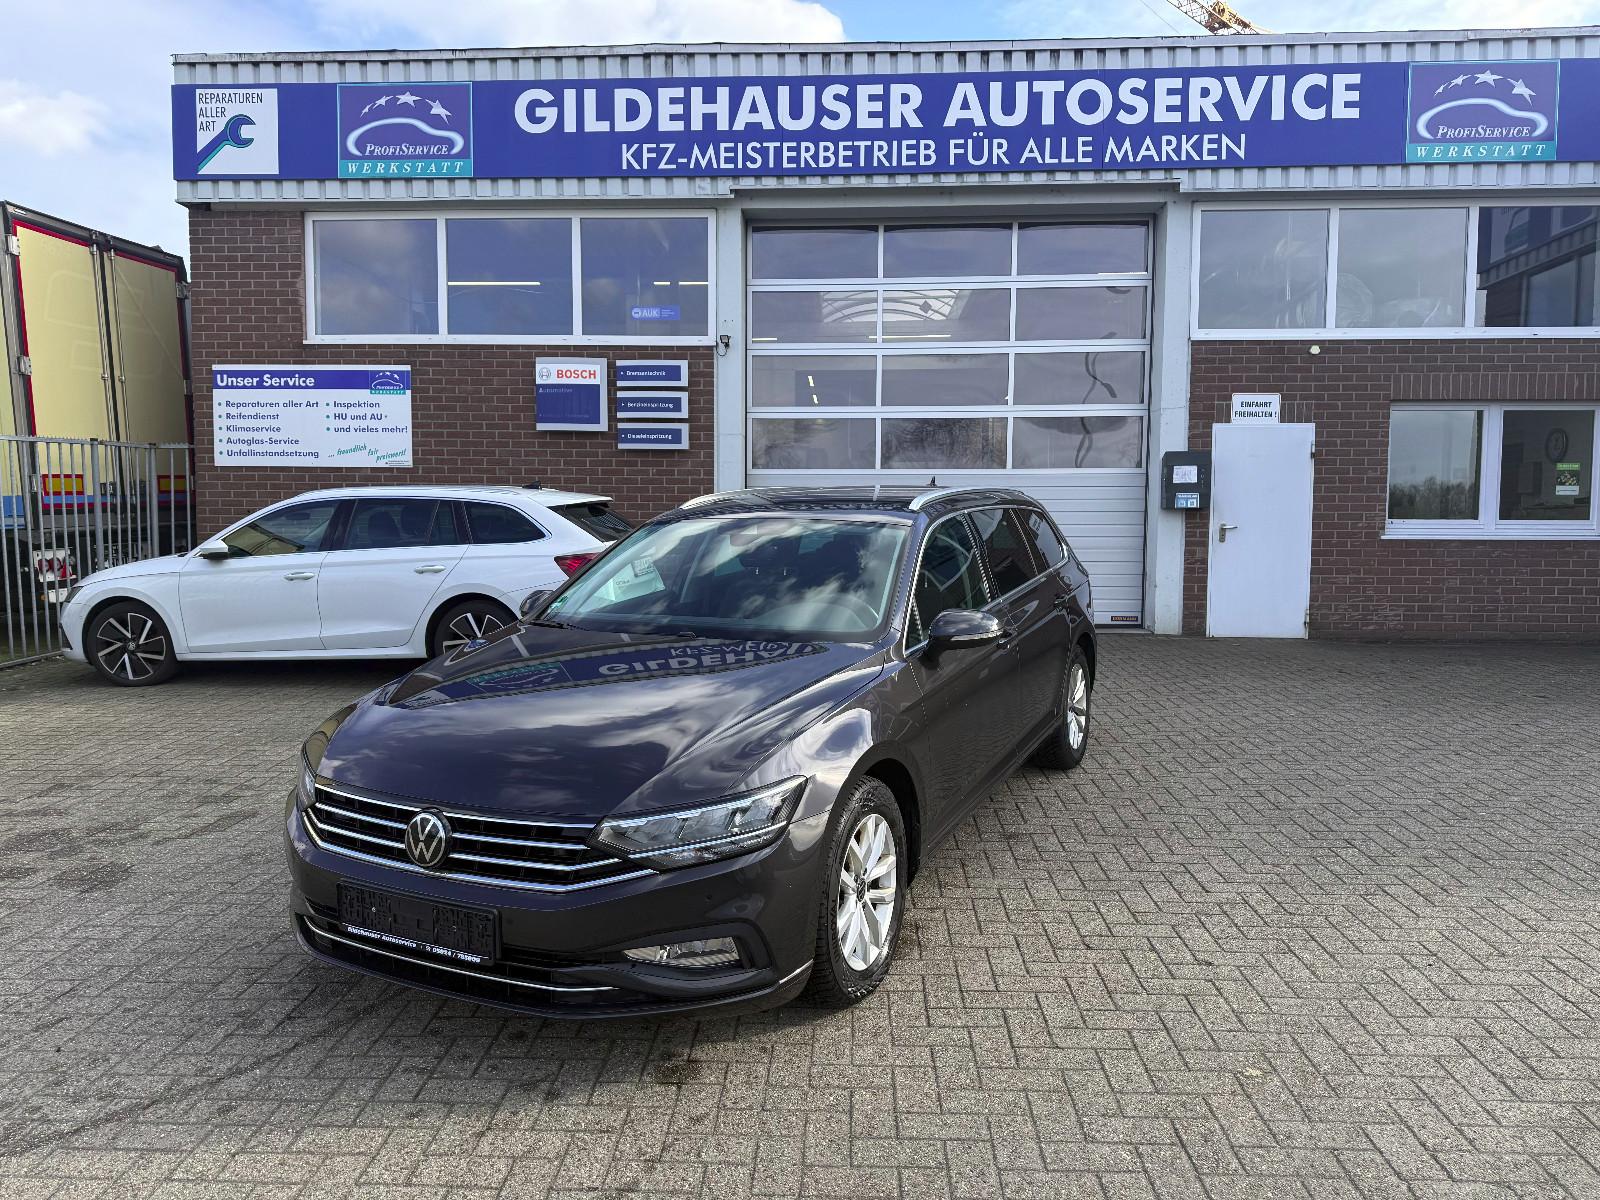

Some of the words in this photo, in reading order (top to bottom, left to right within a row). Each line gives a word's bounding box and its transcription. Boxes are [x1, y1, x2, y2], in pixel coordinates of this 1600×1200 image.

[198, 92, 263, 104] REPARATUREN
[514, 83, 924, 134] GILDEHAUSER
[943, 72, 1362, 127] AUTOSERVICE
[198, 107, 227, 118] ALLER
[198, 121, 217, 132] ART
[622, 139, 937, 170] KFZ-MEISTERBETRIEB
[948, 131, 1010, 167] FÜR
[1020, 134, 1094, 165] ALLE
[1103, 133, 1247, 164] MARKEN
[1416, 144, 1546, 158] WERKSTATT
[347, 161, 463, 174] WERKSTATT
[216, 374, 260, 387] Unser
[262, 373, 315, 387] Service
[556, 369, 597, 380] BOSCH
[225, 400, 280, 409] Reparaturen
[282, 400, 303, 408] aller
[305, 400, 319, 408] Art
[333, 400, 380, 410] Inspektion
[225, 412, 280, 420] Reifendienst
[333, 412, 348, 421] HU
[350, 412, 367, 421] und
[225, 424, 281, 433] Klimaservice
[333, 424, 351, 433] und
[353, 424, 379, 433] vieles
[381, 425, 408, 434] mehr!
[225, 437, 300, 446] Autoglas-Service
[226, 449, 319, 459] Unfallinstandsetzung
[336, 442, 367, 456] freundlich
[367, 447, 379, 457] fair
[375, 448, 407, 463] preiswert!
[381, 935, 417, 948] Autoservice
